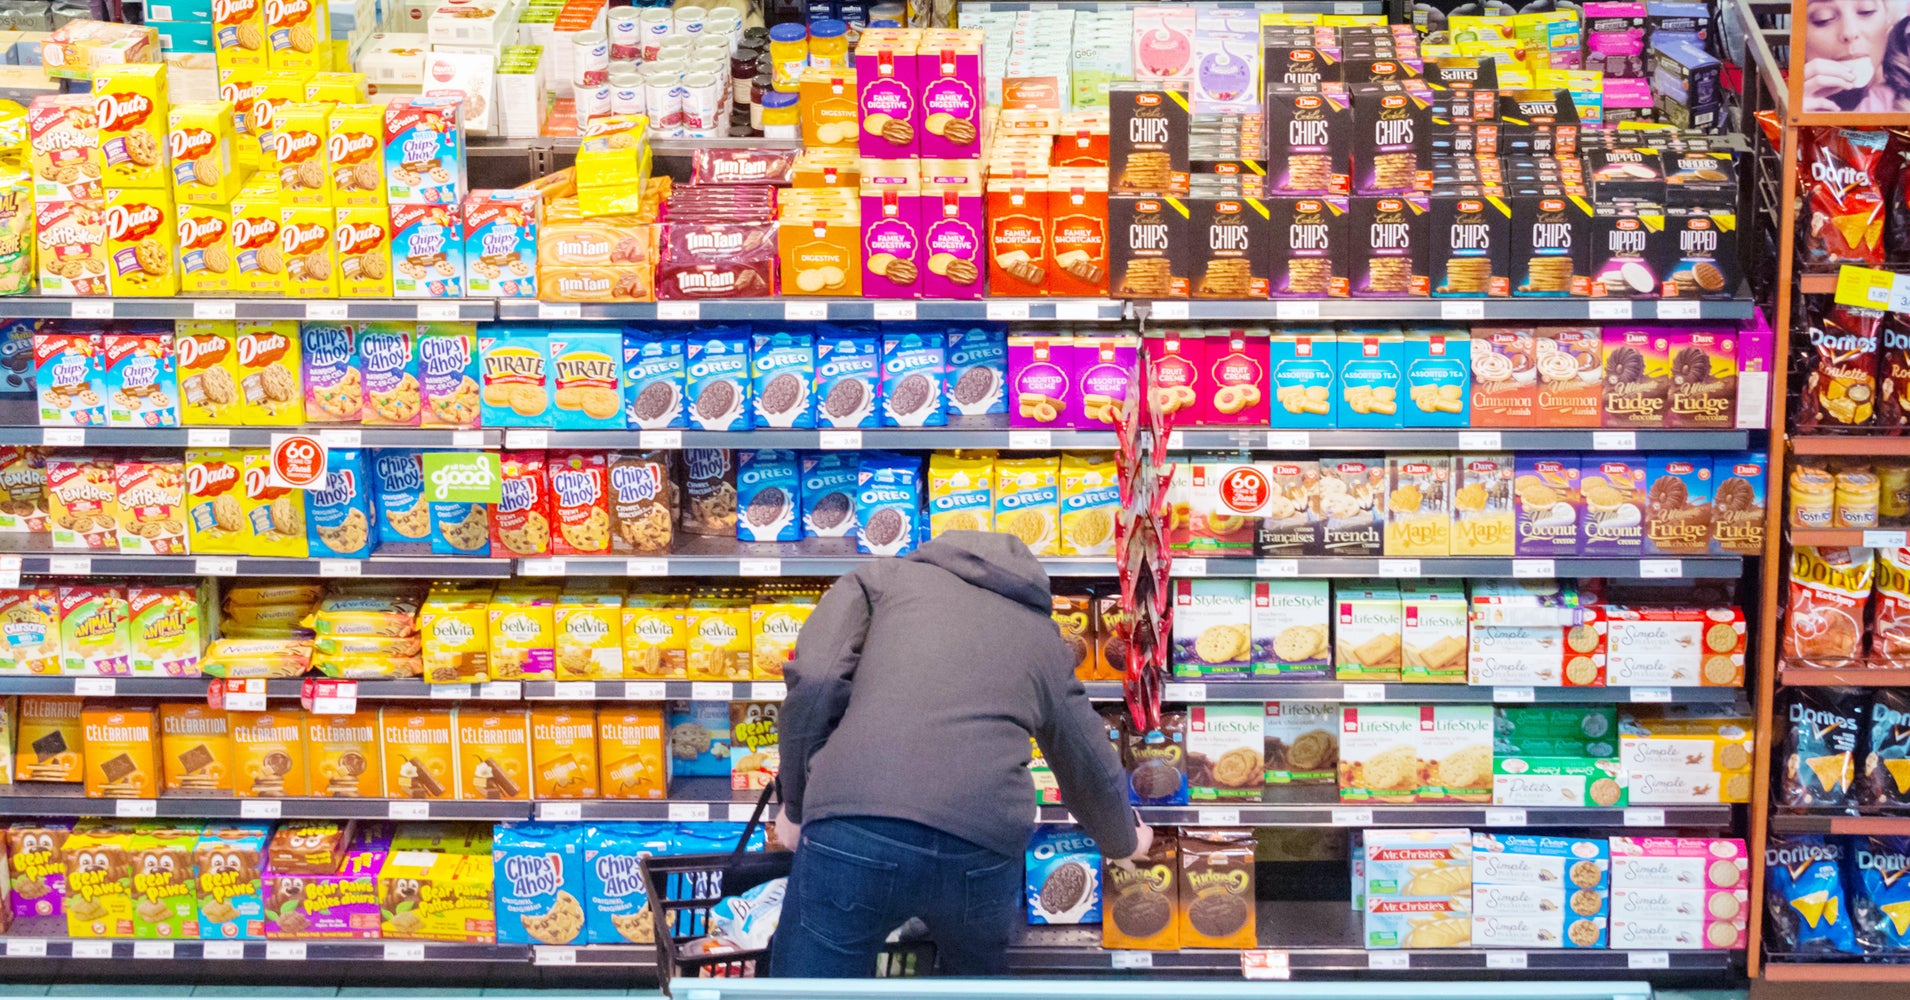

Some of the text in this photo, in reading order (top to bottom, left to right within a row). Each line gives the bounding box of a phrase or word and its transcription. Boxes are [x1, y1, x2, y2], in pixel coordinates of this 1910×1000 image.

[930, 100, 969, 109] DIGESTIVE
[1139, 96, 1158, 104] Dare
[1385, 97, 1404, 106] Dare
[98, 92, 149, 132] Dad's
[1131, 119, 1167, 143] CHIPS
[1376, 121, 1413, 144] CHIPS
[276, 133, 319, 162] Dad's
[331, 134, 373, 164] Dad's
[403, 139, 434, 153] Chips
[1606, 152, 1642, 163] DIPPED
[1461, 202, 1480, 211] Dare
[179, 218, 224, 247] Dad's
[233, 218, 277, 247] Dad's
[337, 225, 383, 254] Dad's
[878, 235, 904, 243] FAMILY
[938, 235, 965, 243] FAMILY
[1055, 236, 1101, 244] SHORTCAKE
[1131, 225, 1167, 249] CHIPS
[1290, 225, 1328, 249] CHIPS
[1451, 225, 1489, 248] CHIPS
[1609, 231, 1645, 251] DIPPED
[1680, 231, 1717, 251] DIPPED
[307, 327, 344, 352] Chips
[1494, 334, 1514, 343] Dare
[1625, 334, 1648, 343] Dare
[1809, 327, 1877, 352] Doritos
[181, 334, 226, 367] Dad's
[951, 346, 1002, 364] OREO
[484, 354, 544, 377] PIRATE
[555, 357, 615, 380] PIRATE
[628, 360, 678, 378] OREO
[691, 360, 741, 377] OREO
[821, 359, 872, 376] OREO
[886, 354, 939, 373] OREO
[1226, 367, 1249, 375] FRUIT
[1022, 376, 1062, 385] ASSORTED
[1275, 371, 1331, 379] ASSORTED TEA
[1344, 372, 1381, 380] ASSORTED
[1410, 370, 1446, 378] ASSORTED
[1473, 393, 1531, 408] Cinnamon
[1538, 392, 1597, 407] Cinnamon
[1609, 394, 1663, 412] Fudge
[1674, 395, 1728, 413] Fudge
[1506, 407, 1531, 416] danish
[286, 442, 314, 459] 60
[377, 455, 415, 479] Chips
[1341, 464, 1363, 472] Dare
[1669, 463, 1691, 473] Dare
[190, 465, 235, 494] Dad's
[612, 467, 651, 492] Chips
[807, 472, 856, 489] OREO
[1231, 473, 1259, 489] 60
[861, 487, 909, 503] OREO
[938, 493, 987, 509] OREO
[1068, 489, 1119, 506] OREO
[1259, 530, 1314, 544] Françaises
[1323, 528, 1379, 542] French
[1392, 522, 1446, 546] Maple
[1457, 521, 1512, 545] Maple
[1520, 521, 1577, 542] Coconut
[1585, 524, 1642, 544] Coconut
[1651, 521, 1706, 540] Fudge
[1273, 595, 1324, 608] LifeStyle
[1816, 590, 1856, 607] Ketchup
[499, 618, 541, 634] belVita
[634, 620, 673, 636] belVita
[1355, 613, 1399, 626] LifeStyle
[1420, 617, 1465, 628] LifeStyle
[433, 620, 474, 638] belVita
[698, 622, 738, 639] belVita
[1282, 704, 1333, 717] LifeStyle
[1789, 703, 1858, 730] Doritos
[1360, 721, 1412, 733] LifeStyle
[1437, 719, 1489, 733] LifeStyle
[1034, 837, 1095, 860] OREO
[1382, 849, 1445, 859] Mr. Christie's
[1766, 845, 1831, 866] Doritos
[507, 856, 550, 882] Chips
[1382, 901, 1445, 911] Mr. Christie's
